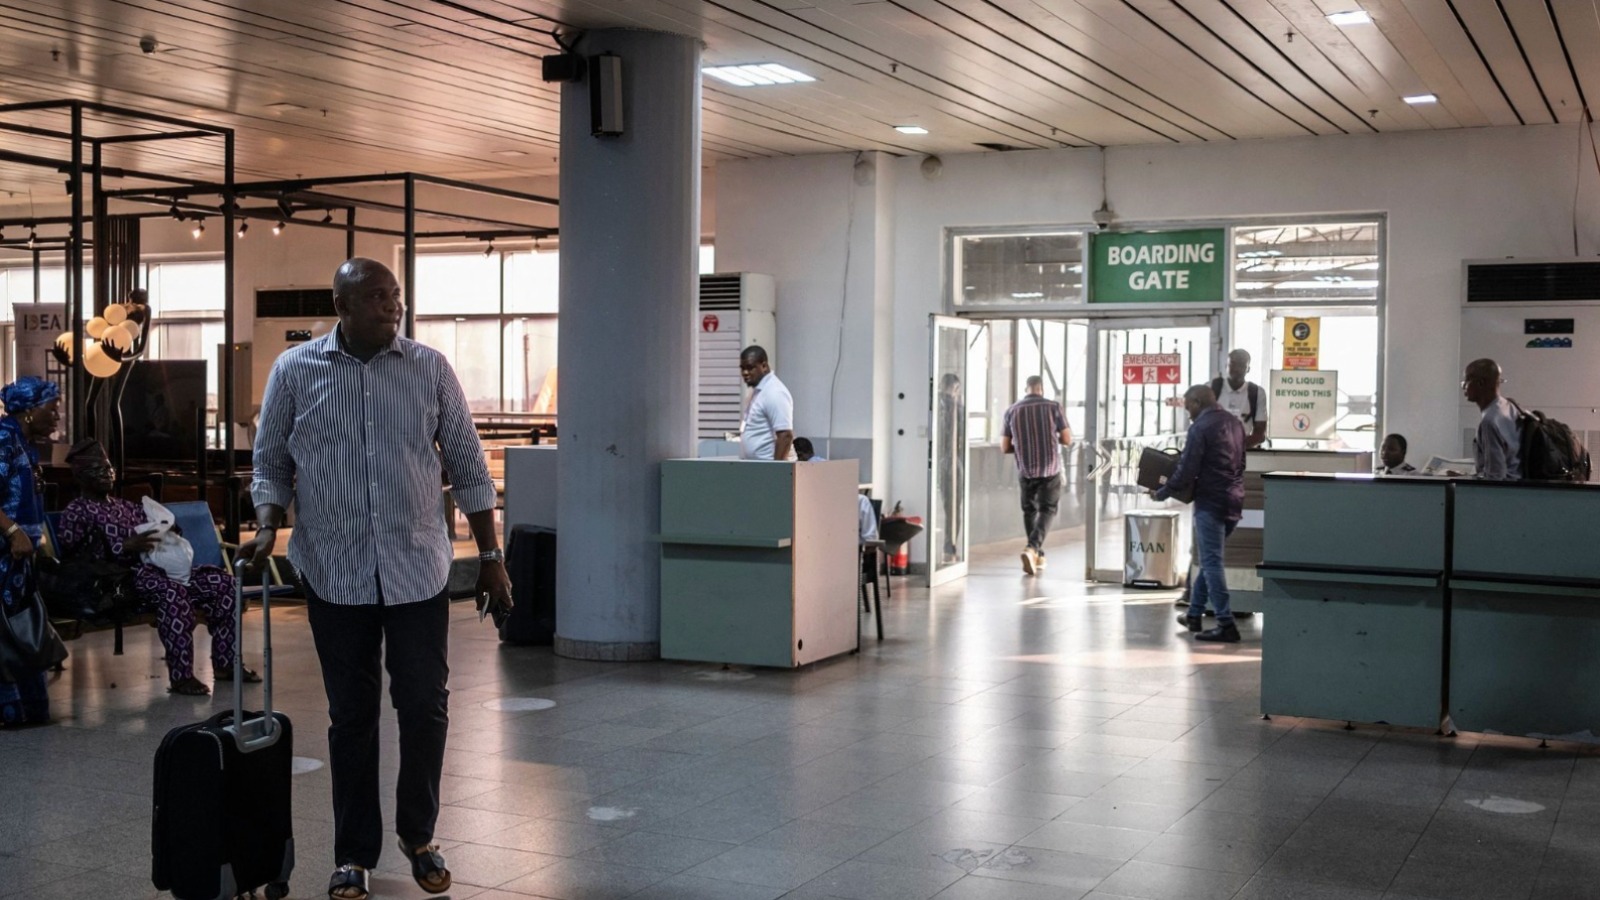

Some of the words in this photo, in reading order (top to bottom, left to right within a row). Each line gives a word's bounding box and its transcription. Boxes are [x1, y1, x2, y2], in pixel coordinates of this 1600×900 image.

[1107, 243, 1215, 265] BOARDING
[1128, 270, 1190, 290] GATE
[1124, 355, 1178, 365] EMERGENCY
[1281, 376, 1293, 385] NO
[1296, 376, 1325, 385] LIQUID
[1275, 388, 1310, 397] BEYOND
[1312, 389, 1332, 397] THIS
[1289, 402, 1315, 410] POINT
[1130, 541, 1166, 553] FAAN
